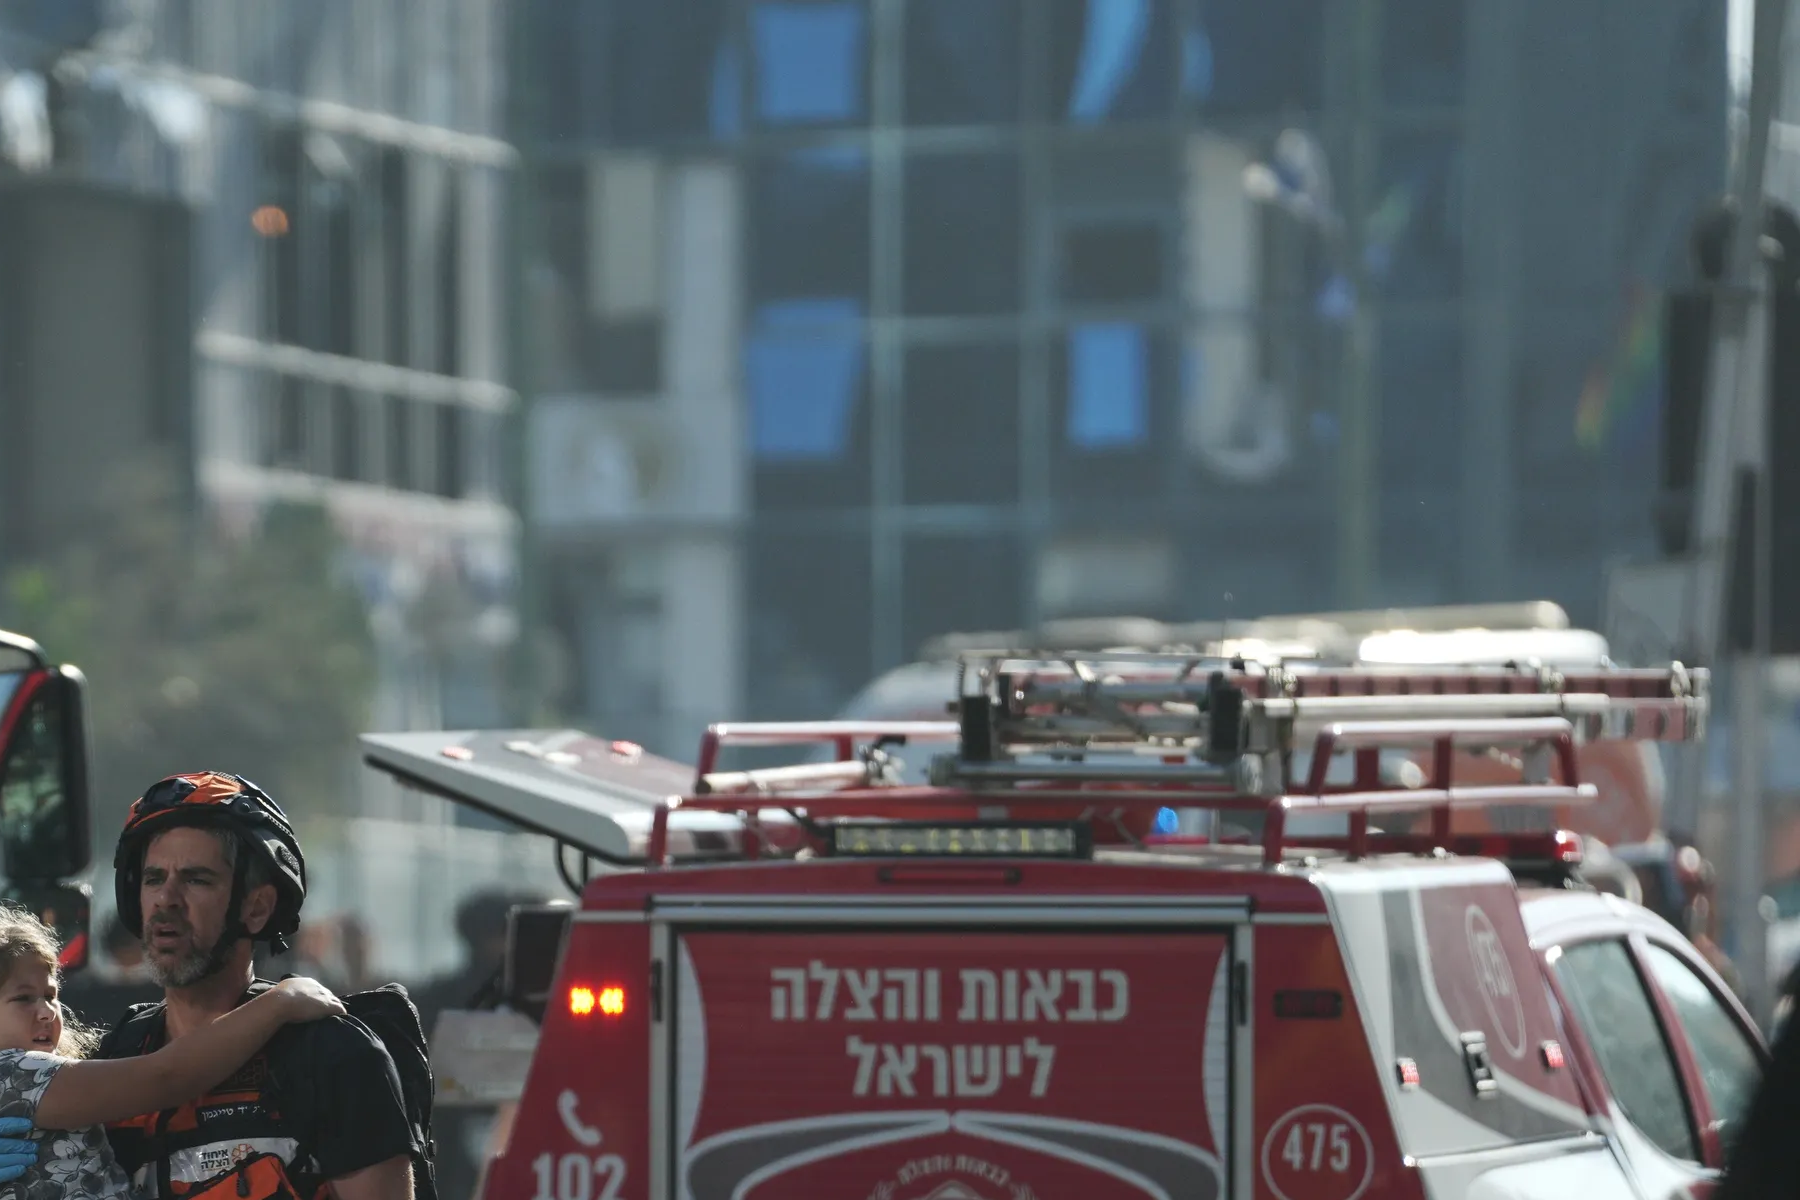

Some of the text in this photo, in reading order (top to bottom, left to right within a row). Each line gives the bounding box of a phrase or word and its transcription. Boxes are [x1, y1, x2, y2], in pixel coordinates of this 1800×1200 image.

[770, 960, 1129, 1021] כבאות והצלה
[846, 1036, 1055, 1097] לישראל
[201, 1158, 230, 1170] הצלה
[202, 1148, 229, 1160] איחוד
[1282, 1122, 1351, 1172] 475
